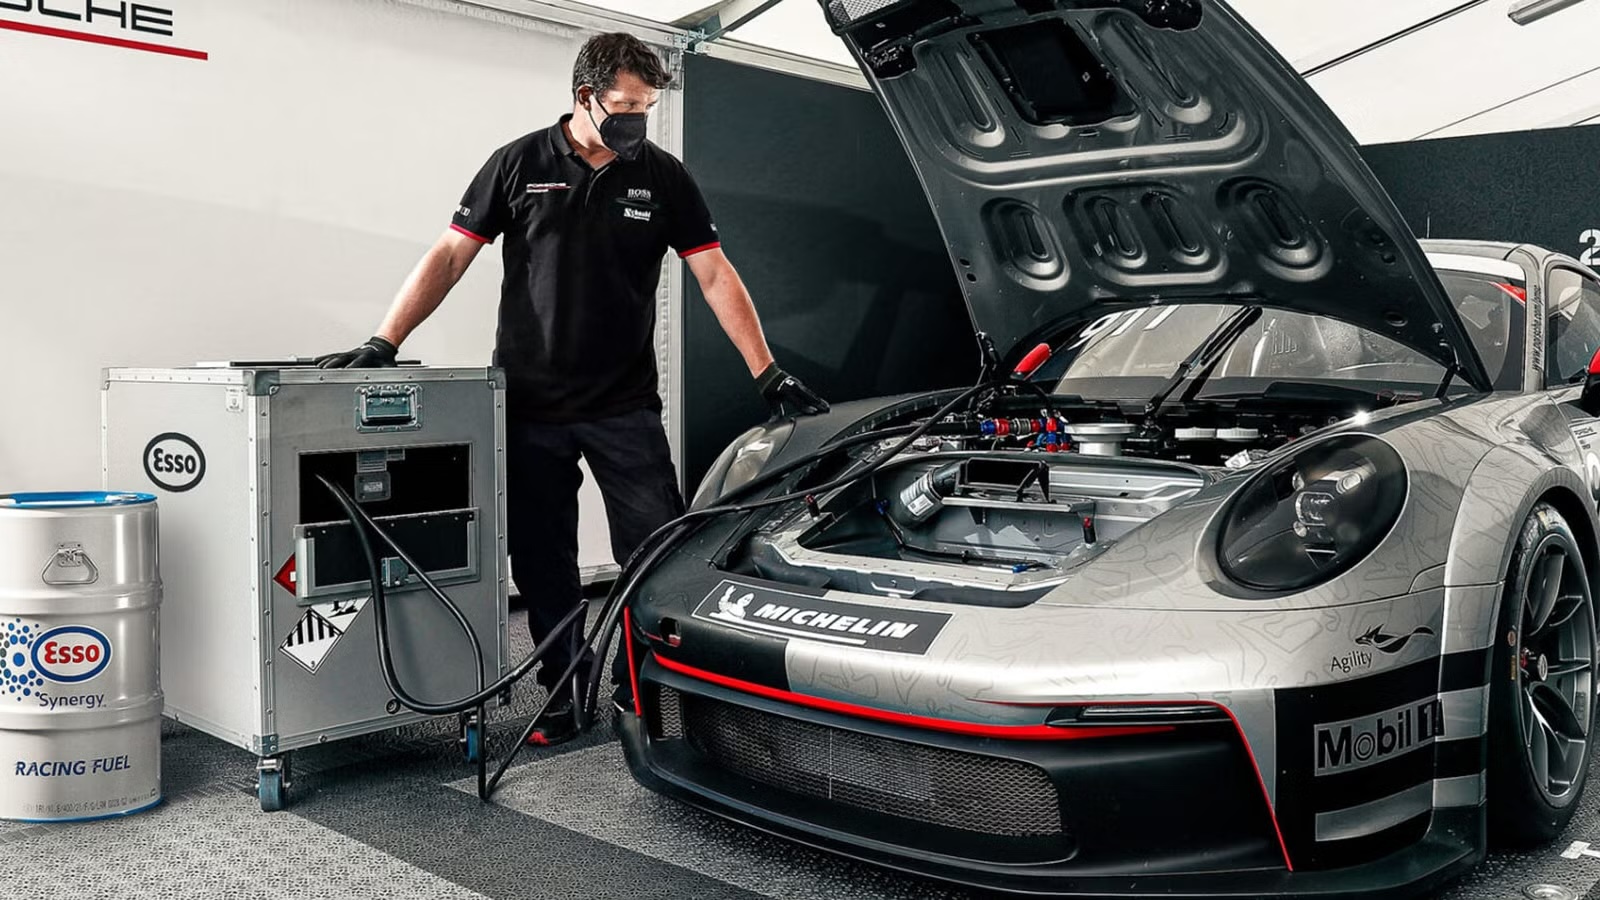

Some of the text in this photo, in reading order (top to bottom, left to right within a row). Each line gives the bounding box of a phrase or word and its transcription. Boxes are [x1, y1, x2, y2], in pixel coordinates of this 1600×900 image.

[153, 447, 197, 474] Esso
[753, 602, 919, 639] MICHELIN
[44, 641, 100, 664] Esso
[1330, 650, 1374, 673] Agility
[39, 692, 105, 710] Synergy
[1317, 709, 1412, 769] Mobil
[15, 755, 131, 777] RACING FUEL
